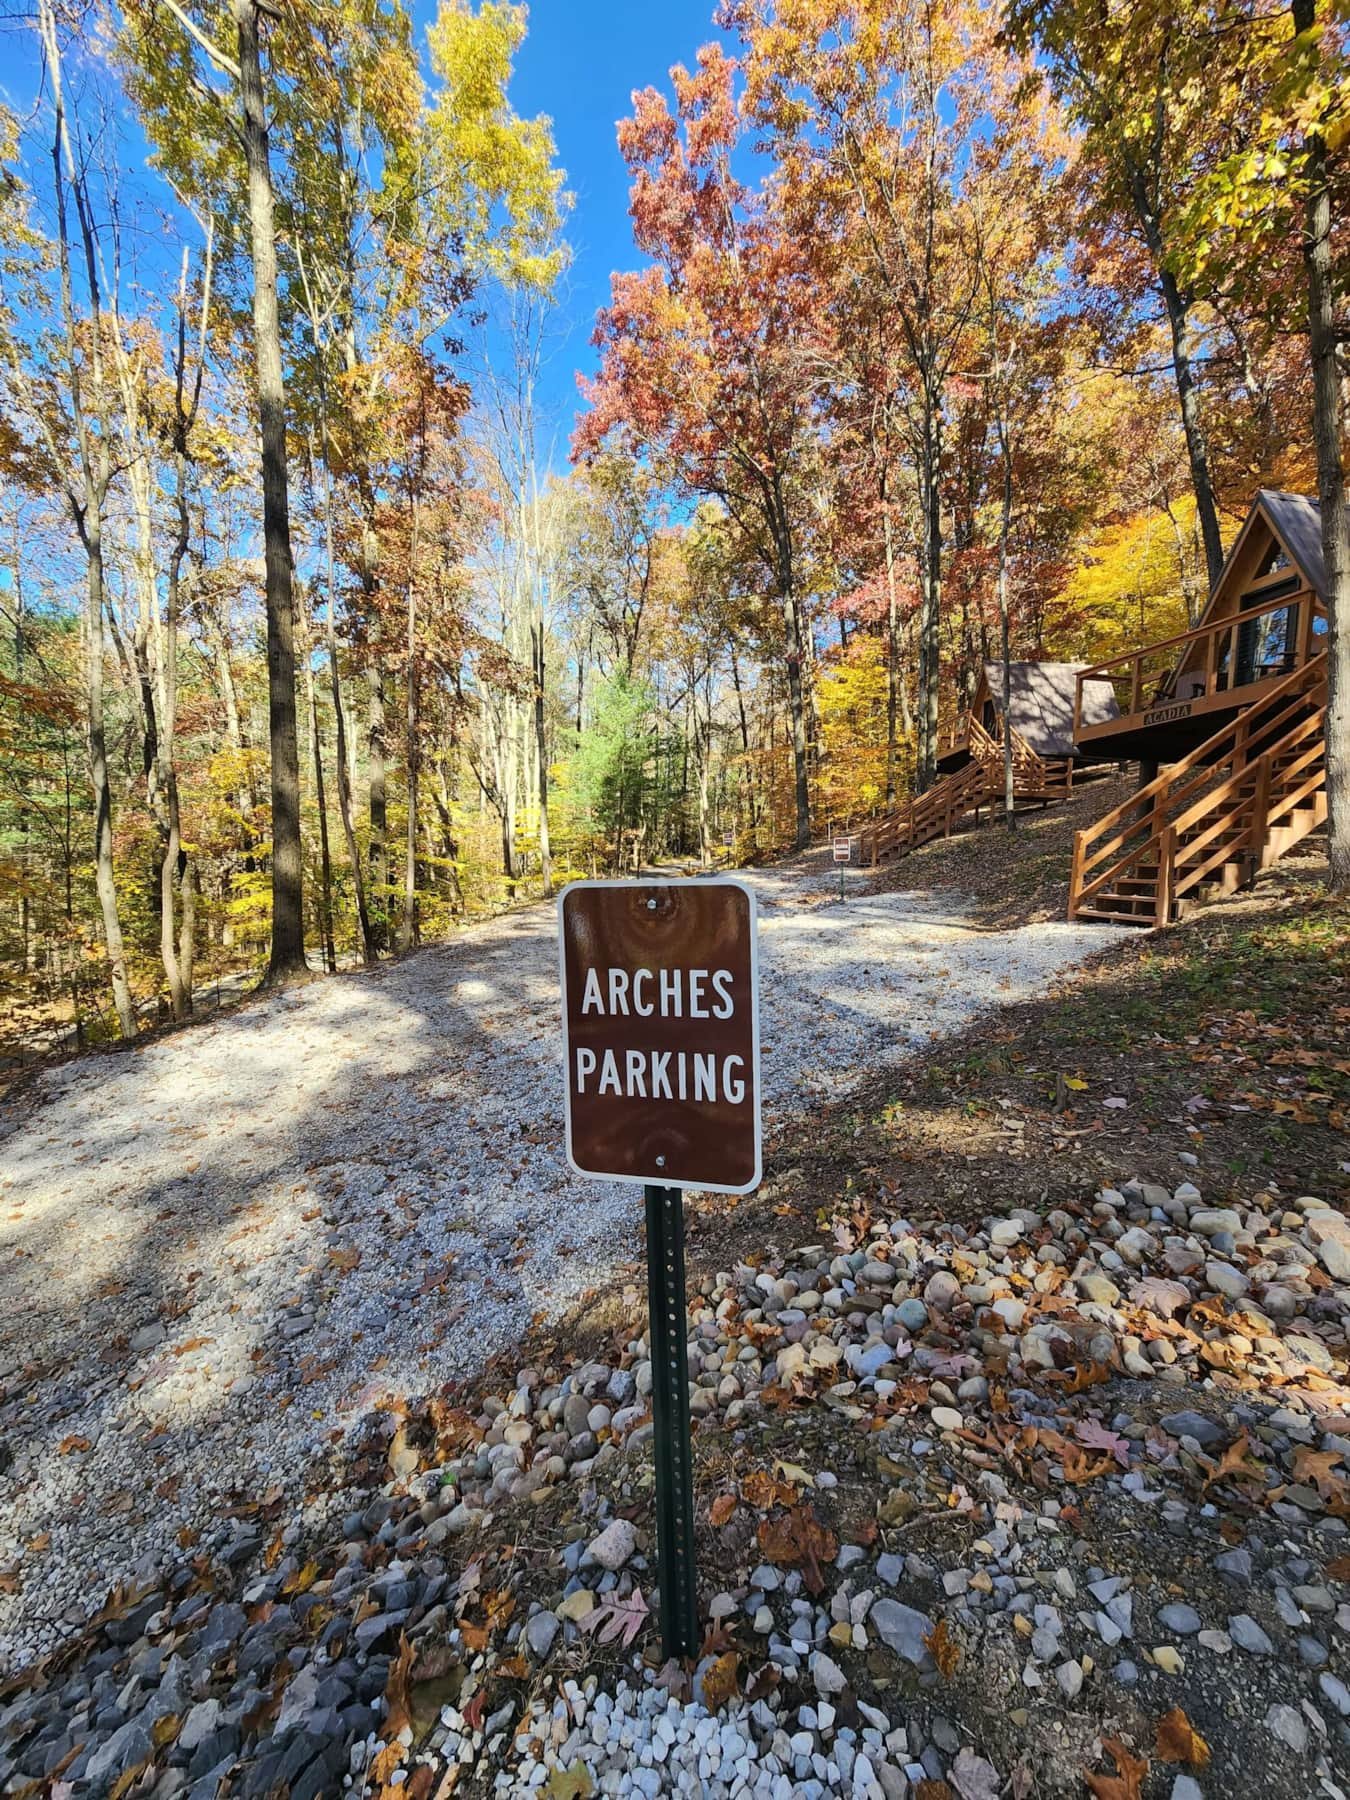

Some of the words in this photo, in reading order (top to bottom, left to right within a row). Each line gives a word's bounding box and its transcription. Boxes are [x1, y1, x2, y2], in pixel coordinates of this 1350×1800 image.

[1147, 706, 1188, 724] ACADIA
[582, 968, 734, 1019] ARCHES
[576, 1047, 745, 1104] PARKING
